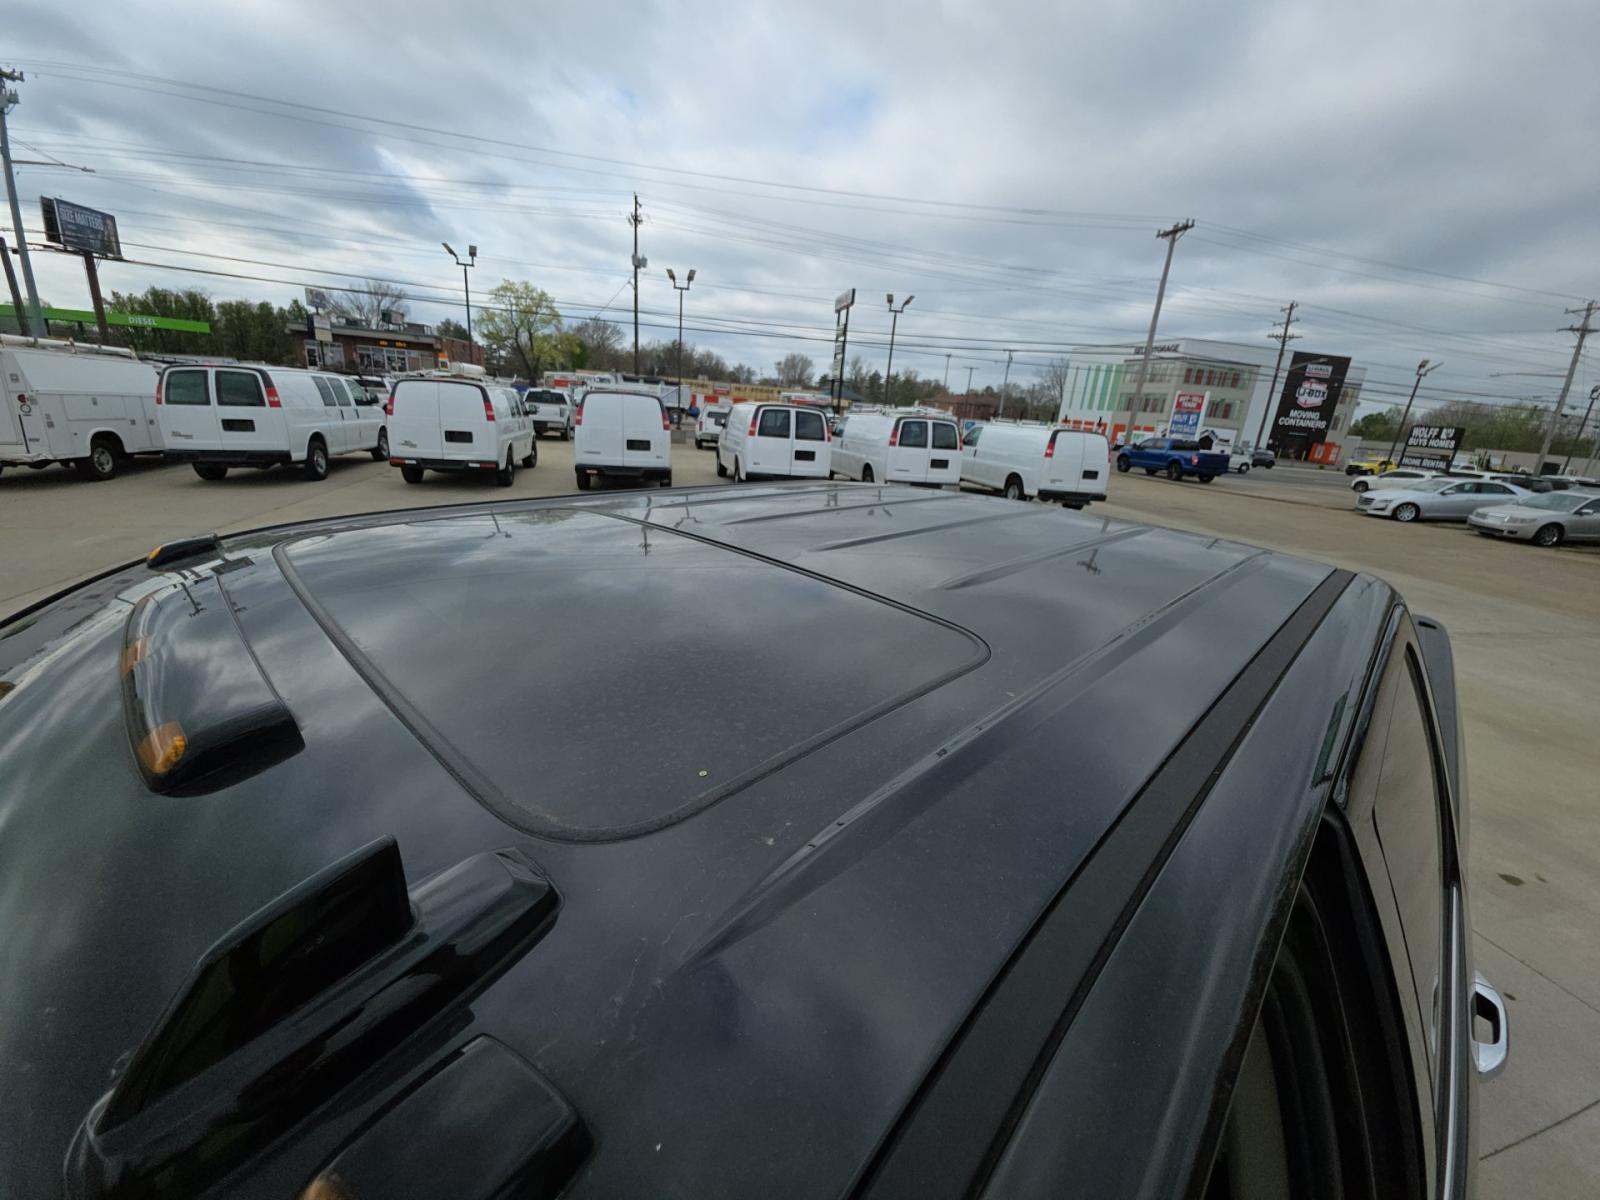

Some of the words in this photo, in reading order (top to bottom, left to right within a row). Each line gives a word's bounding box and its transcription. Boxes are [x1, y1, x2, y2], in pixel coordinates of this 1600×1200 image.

[128, 316, 157, 326] DIESEL
[1289, 409, 1320, 420] MOVING
[1278, 417, 1327, 429] CONTAINERS
[1412, 427, 1439, 438] WOLFF
[1408, 437, 1427, 446] BUYS
[1428, 439, 1456, 449] HOMES
[1401, 457, 1421, 466] HOME
